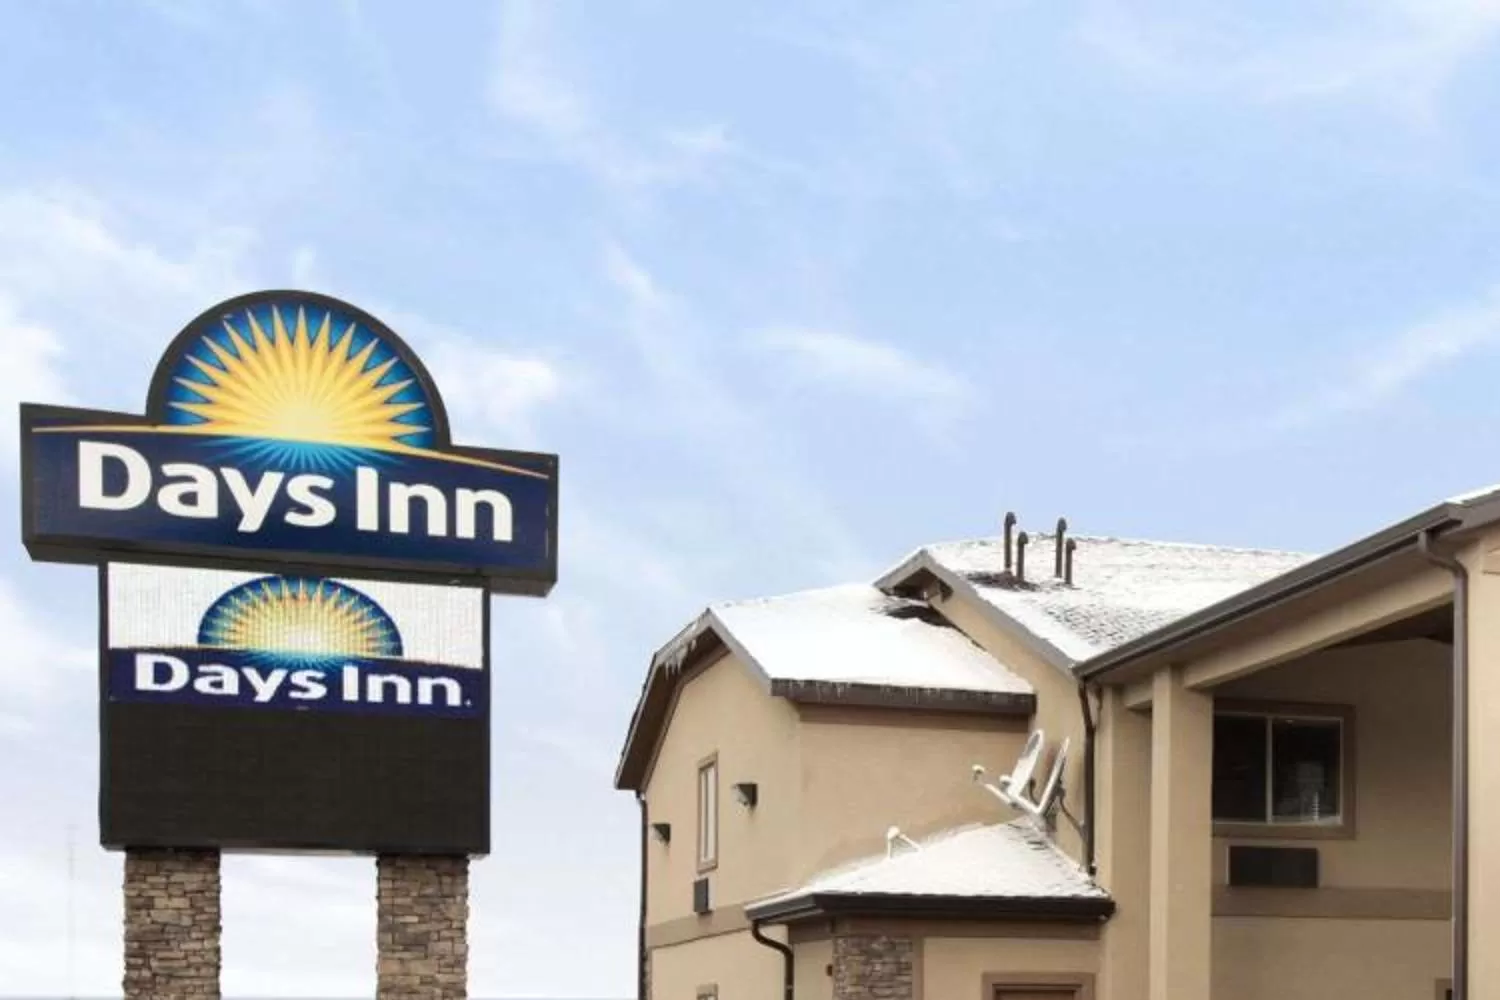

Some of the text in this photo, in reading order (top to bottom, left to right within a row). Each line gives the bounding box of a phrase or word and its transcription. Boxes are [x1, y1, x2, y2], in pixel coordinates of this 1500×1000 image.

[78, 440, 512, 542] Days Inn
[134, 653, 462, 707] Days Inn
